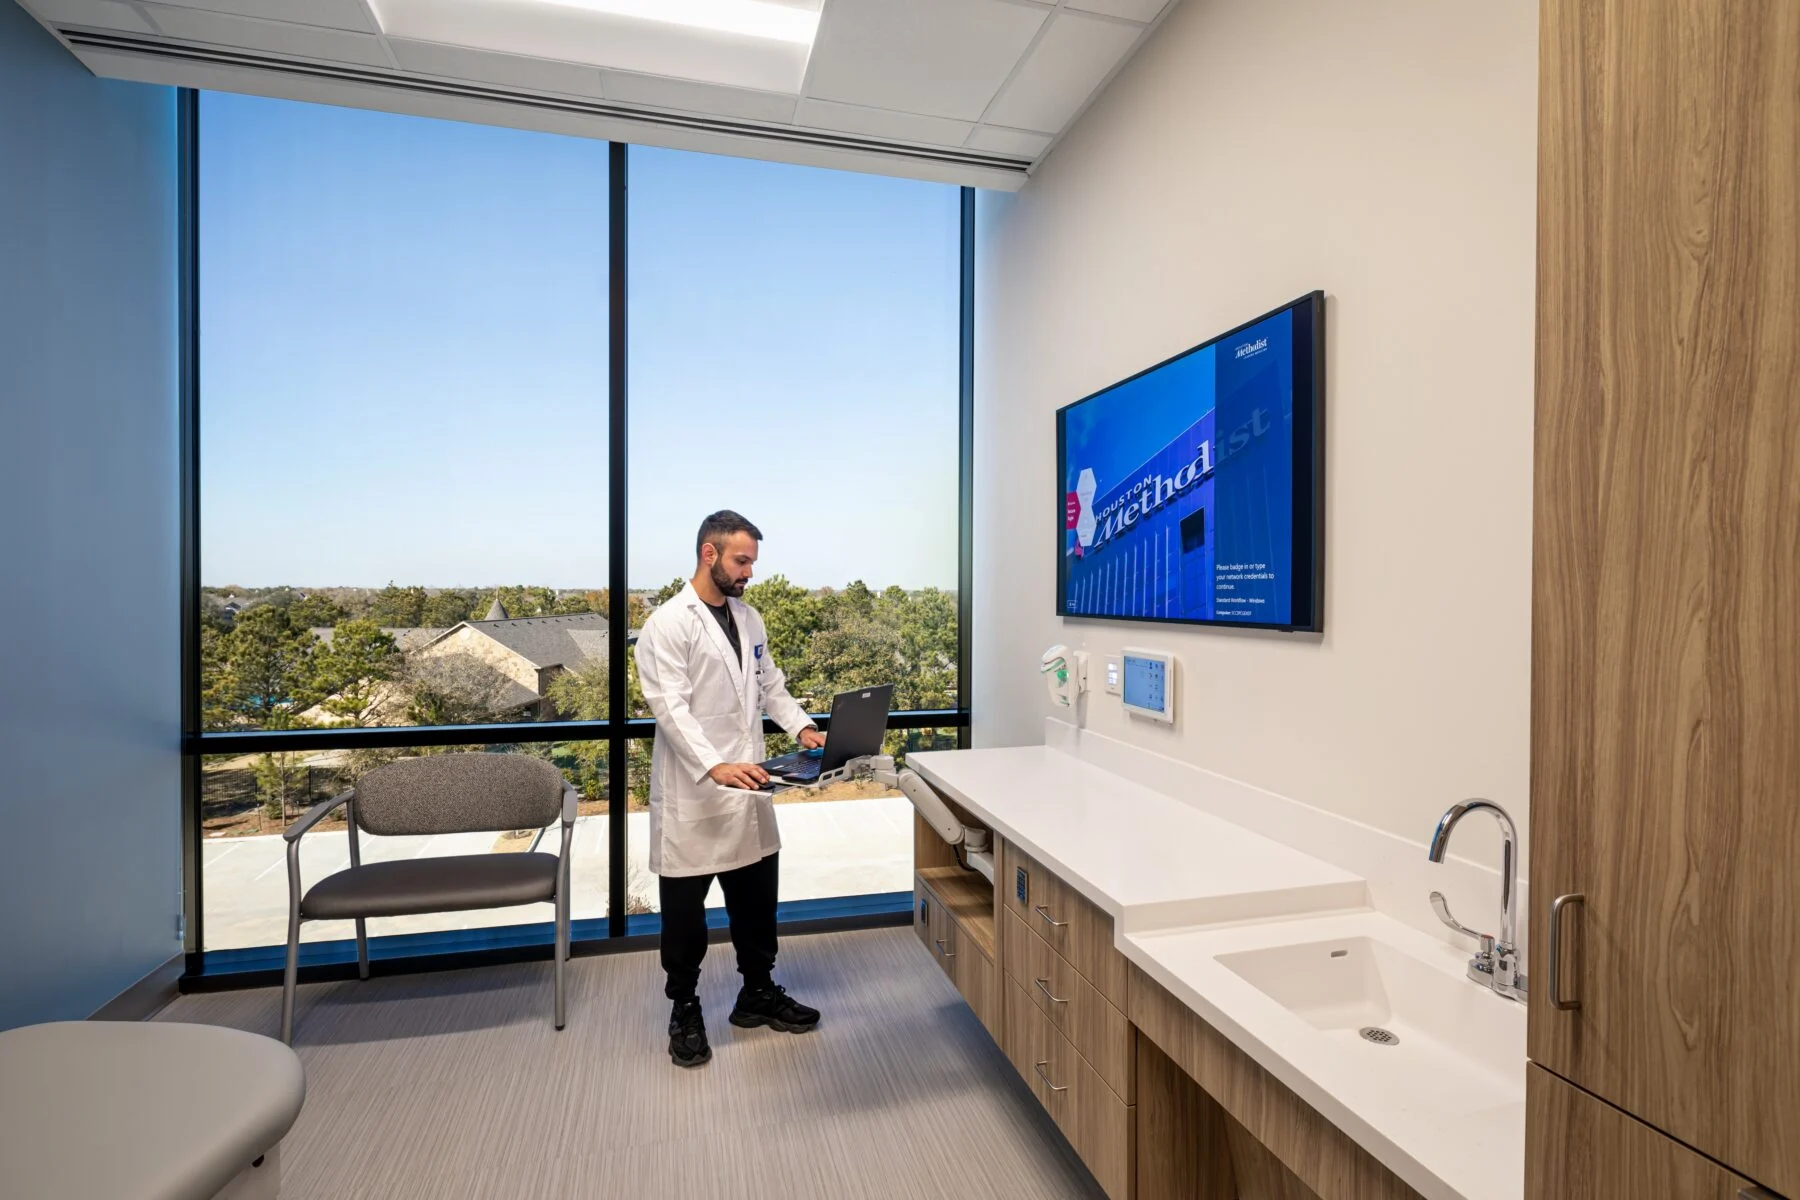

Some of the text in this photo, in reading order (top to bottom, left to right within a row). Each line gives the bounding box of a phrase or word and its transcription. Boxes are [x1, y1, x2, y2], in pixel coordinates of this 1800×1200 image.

[1235, 338, 1267, 359] Methodist
[1094, 406, 1271, 548] Methodist
[1095, 474, 1153, 522] HOUSTON
[1230, 563, 1243, 571] badge
